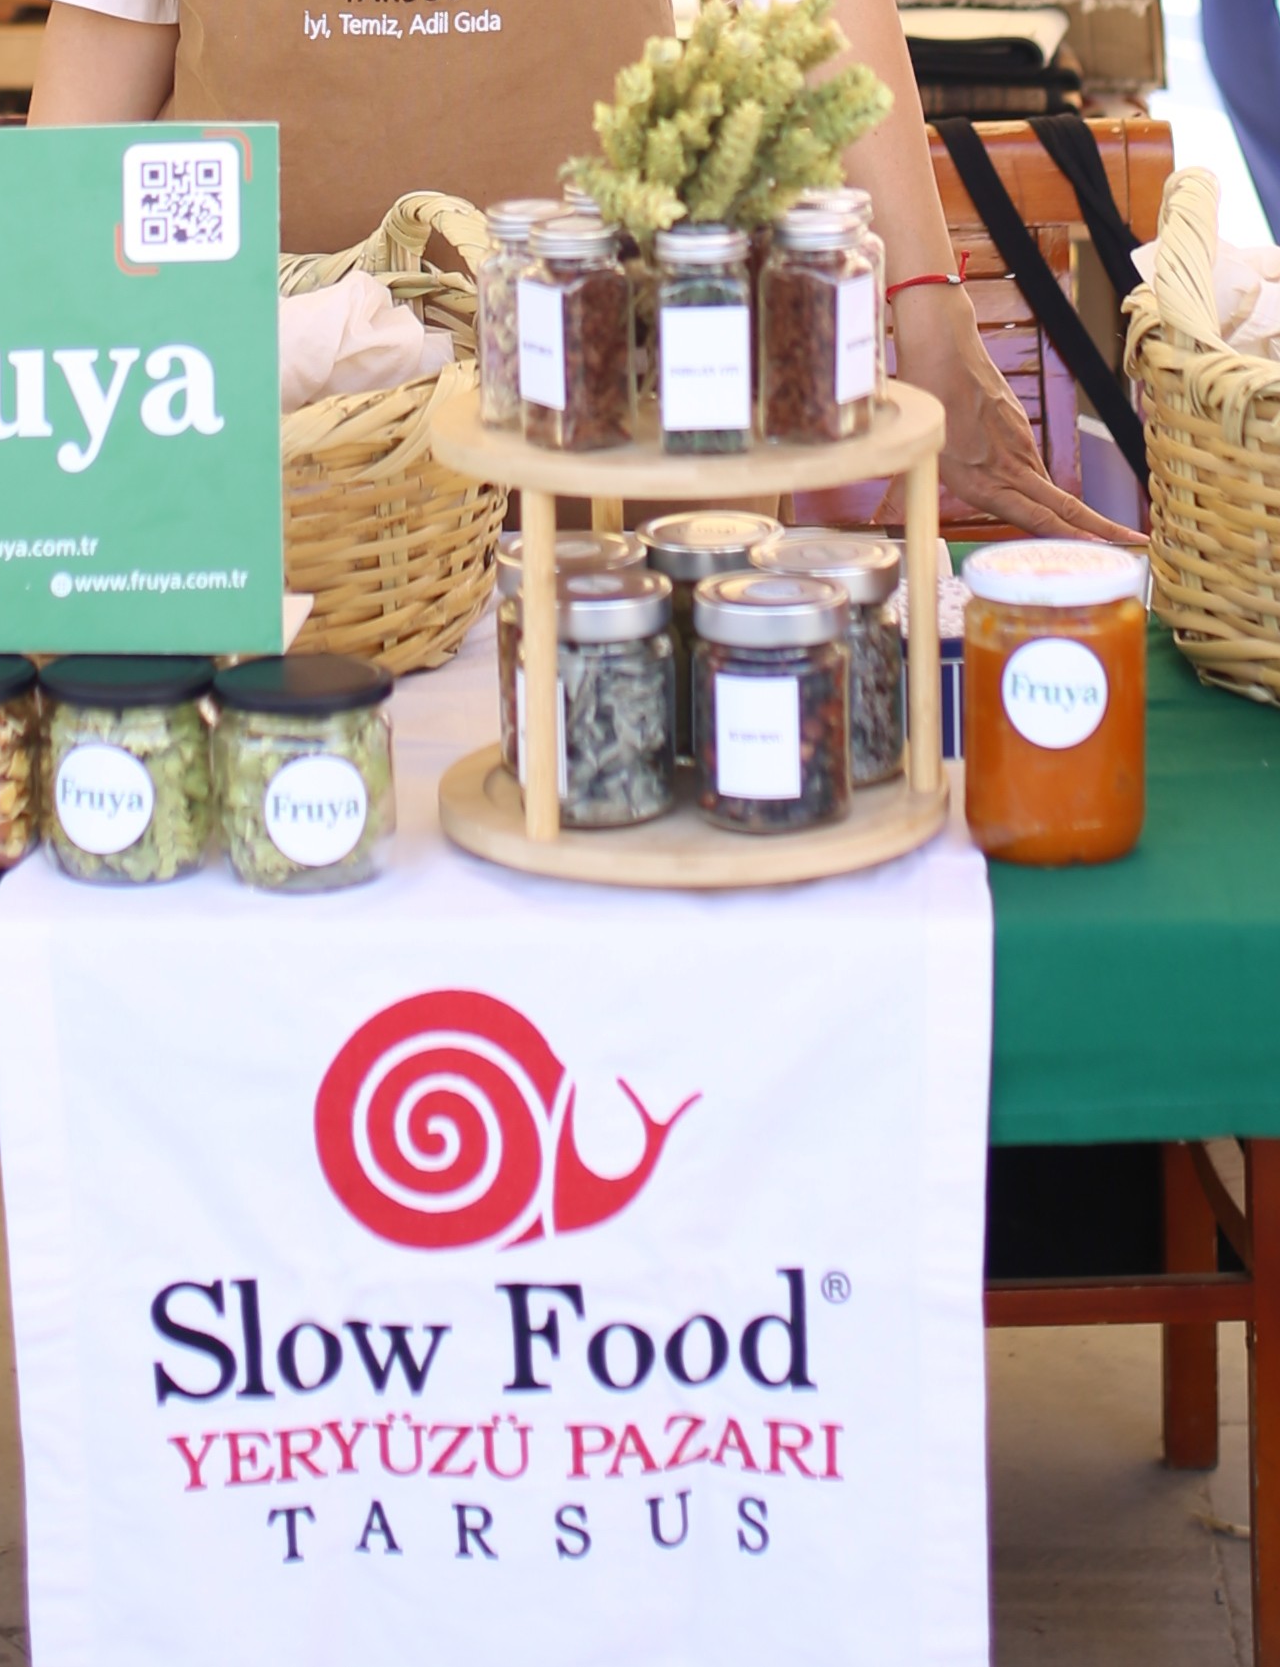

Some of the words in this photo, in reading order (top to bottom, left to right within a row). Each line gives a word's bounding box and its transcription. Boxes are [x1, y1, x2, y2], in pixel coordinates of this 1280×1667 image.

[303, 10, 332, 41] İyi,
[338, 12, 404, 40] Temiz,
[409, 10, 449, 36] Adil
[454, 9, 502, 35] Gıda
[74, 568, 250, 594] www.fruya.com.tr
[1012, 672, 1099, 713] Fruya
[60, 777, 145, 818] Fruya
[272, 793, 361, 830] Fruya
[149, 1277, 453, 1406] Slow
[167, 1412, 535, 1493] YERYÜZÜ
[565, 1413, 846, 1483] PAZARI
[266, 1489, 773, 1565] TARSUS
